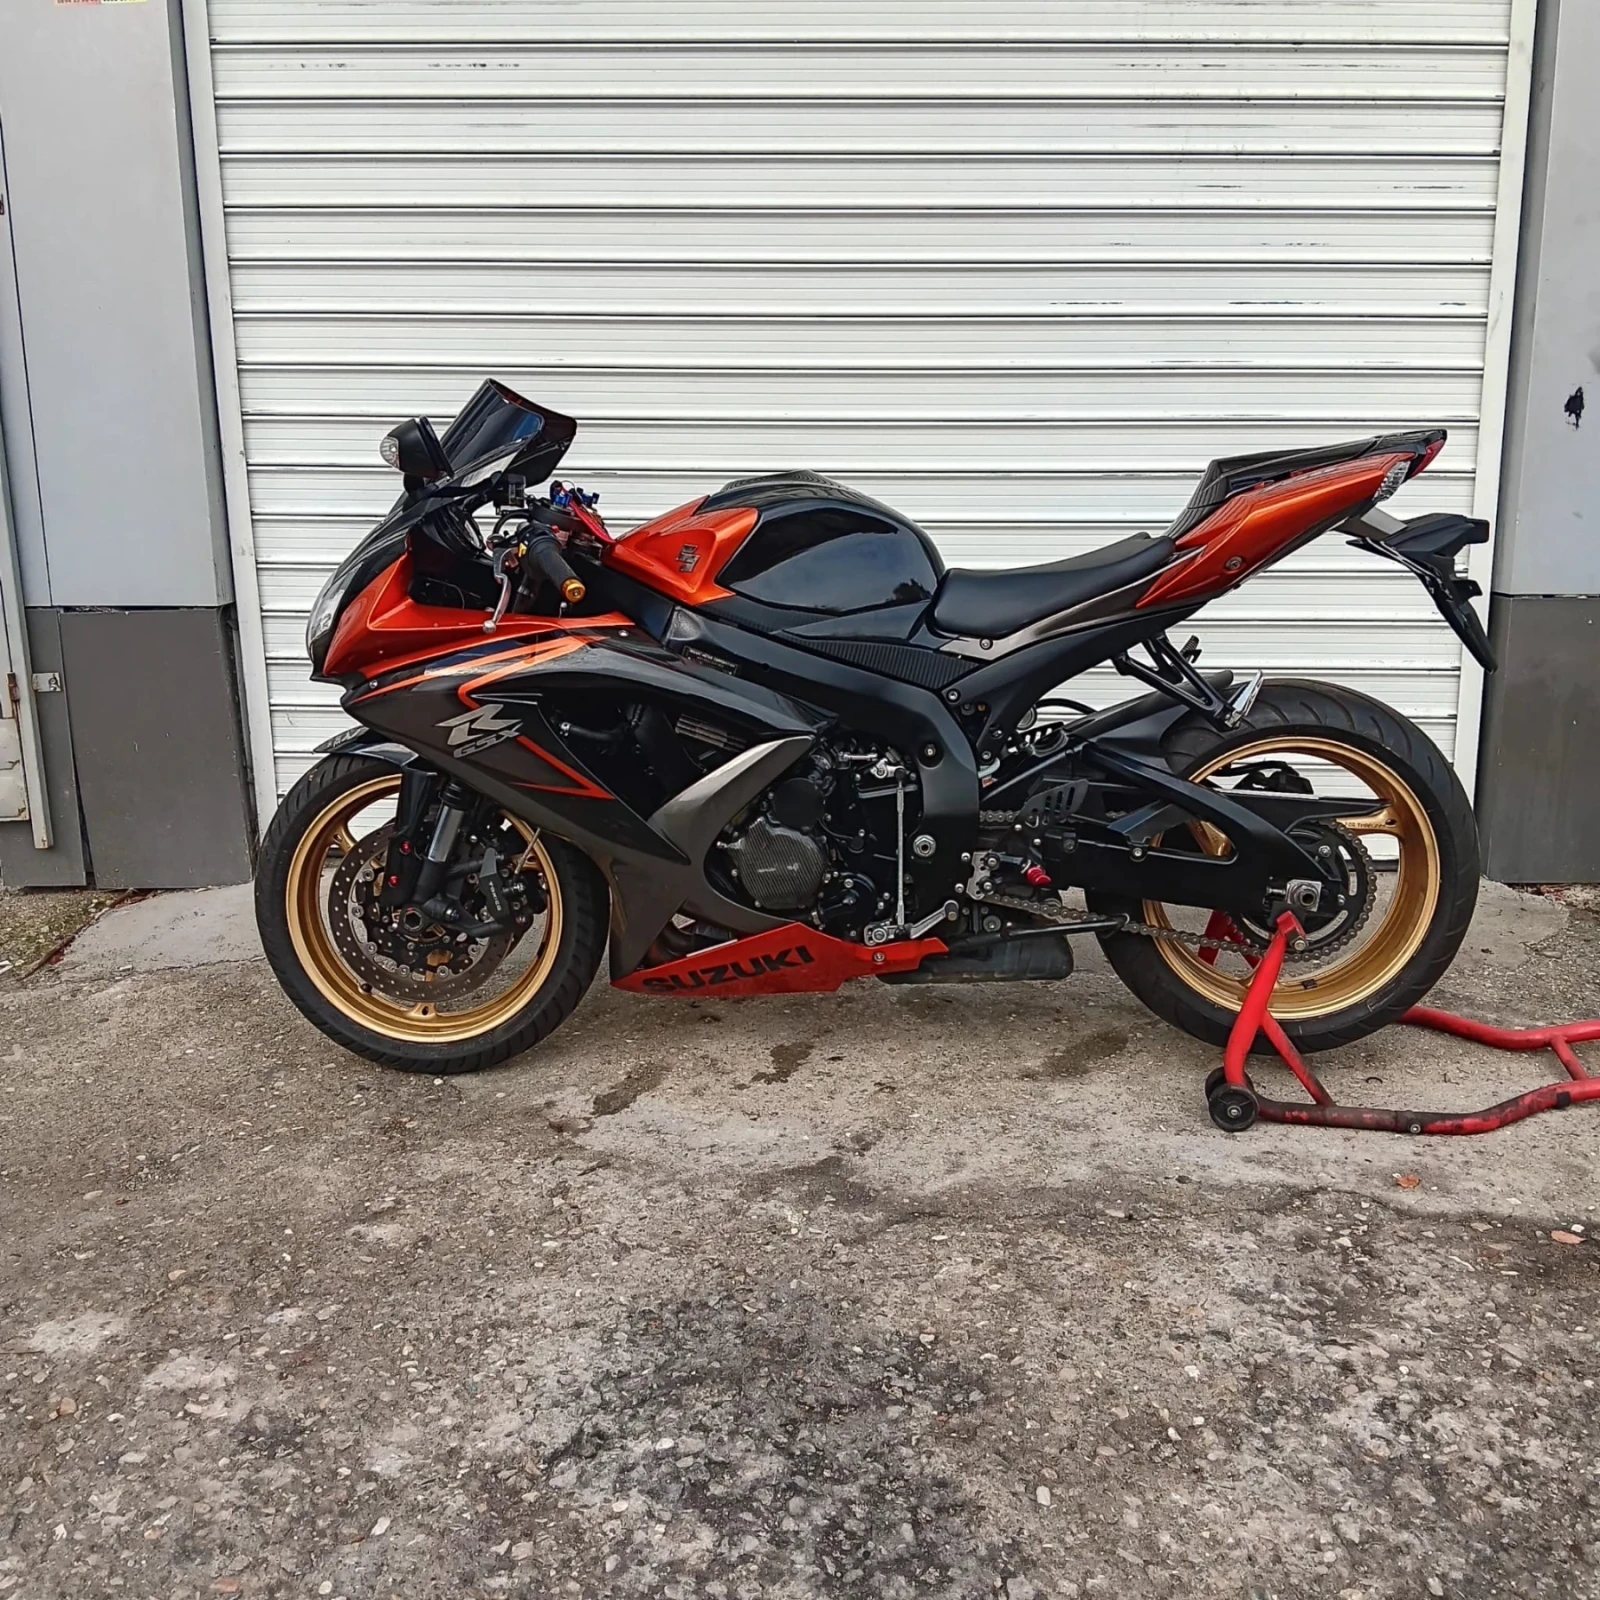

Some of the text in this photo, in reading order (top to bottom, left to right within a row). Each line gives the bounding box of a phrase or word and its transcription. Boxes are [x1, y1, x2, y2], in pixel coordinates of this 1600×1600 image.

[434, 703, 522, 745] R
[453, 722, 524, 758] GSX
[642, 945, 815, 992] SUZUKI
